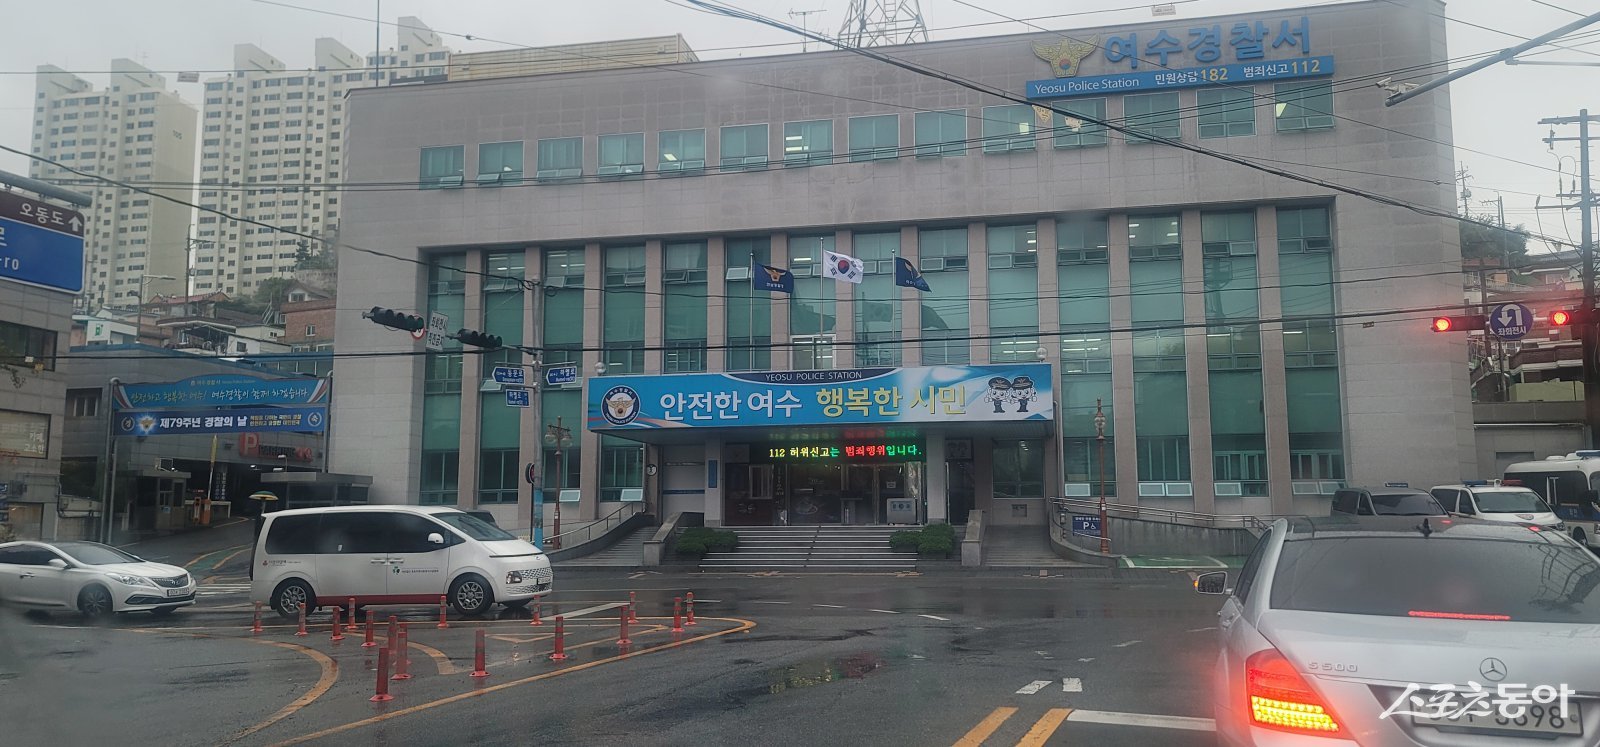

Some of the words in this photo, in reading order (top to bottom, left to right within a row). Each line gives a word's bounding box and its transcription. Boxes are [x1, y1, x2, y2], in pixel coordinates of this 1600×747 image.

[1104, 16, 1310, 69] 여수경찰서
[1035, 84, 1066, 98] Yeosu
[1069, 79, 1099, 94] Police
[1101, 76, 1139, 91] Station
[1155, 71, 1199, 88] 민원상담
[1200, 67, 1228, 82] 182
[1243, 64, 1289, 80] 범죄신고
[1291, 60, 1321, 75] 112
[20, 203, 65, 225] 오동도
[1498, 325, 1527, 336] 좌회전시
[766, 374, 793, 382] YEOSU
[796, 372, 825, 380] POLICE
[828, 371, 862, 380] STATION
[660, 391, 742, 421] 안전한
[747, 389, 802, 418] 여수
[816, 386, 903, 418] 행복한
[910, 385, 966, 416] 시민
[160, 416, 201, 429] 제79주년
[205, 415, 234, 428] 경찰의
[237, 415, 248, 427] 날
[769, 447, 785, 458] 112
[790, 446, 840, 459] 허위신고는
[845, 444, 922, 458] 범죄행위입니다.
[1083, 521, 1090, 531] P
